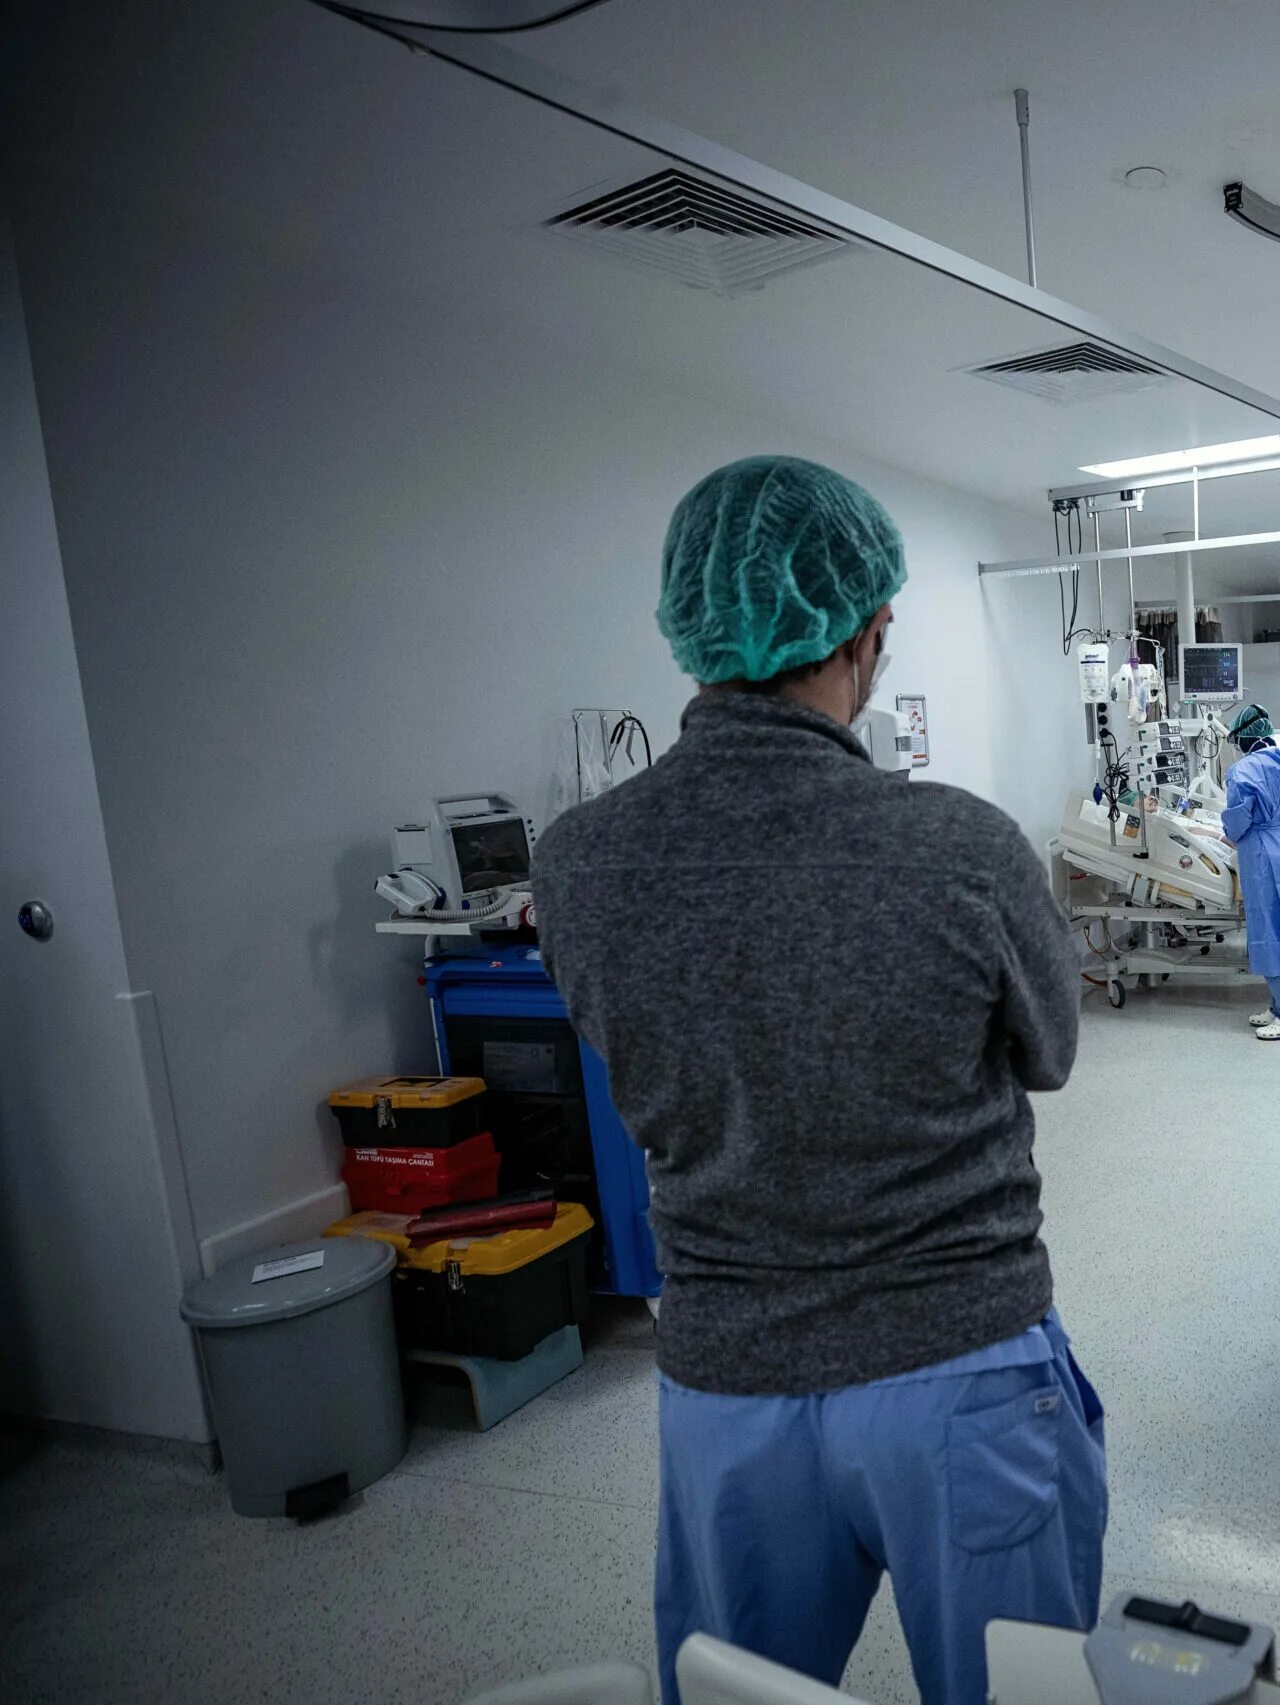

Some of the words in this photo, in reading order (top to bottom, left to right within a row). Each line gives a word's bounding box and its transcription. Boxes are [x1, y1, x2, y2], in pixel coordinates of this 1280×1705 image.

[370, 1154, 384, 1162] TÜPÜ
[385, 1156, 407, 1164] TAŞIMA
[408, 1158, 434, 1166] ÇANTASI
